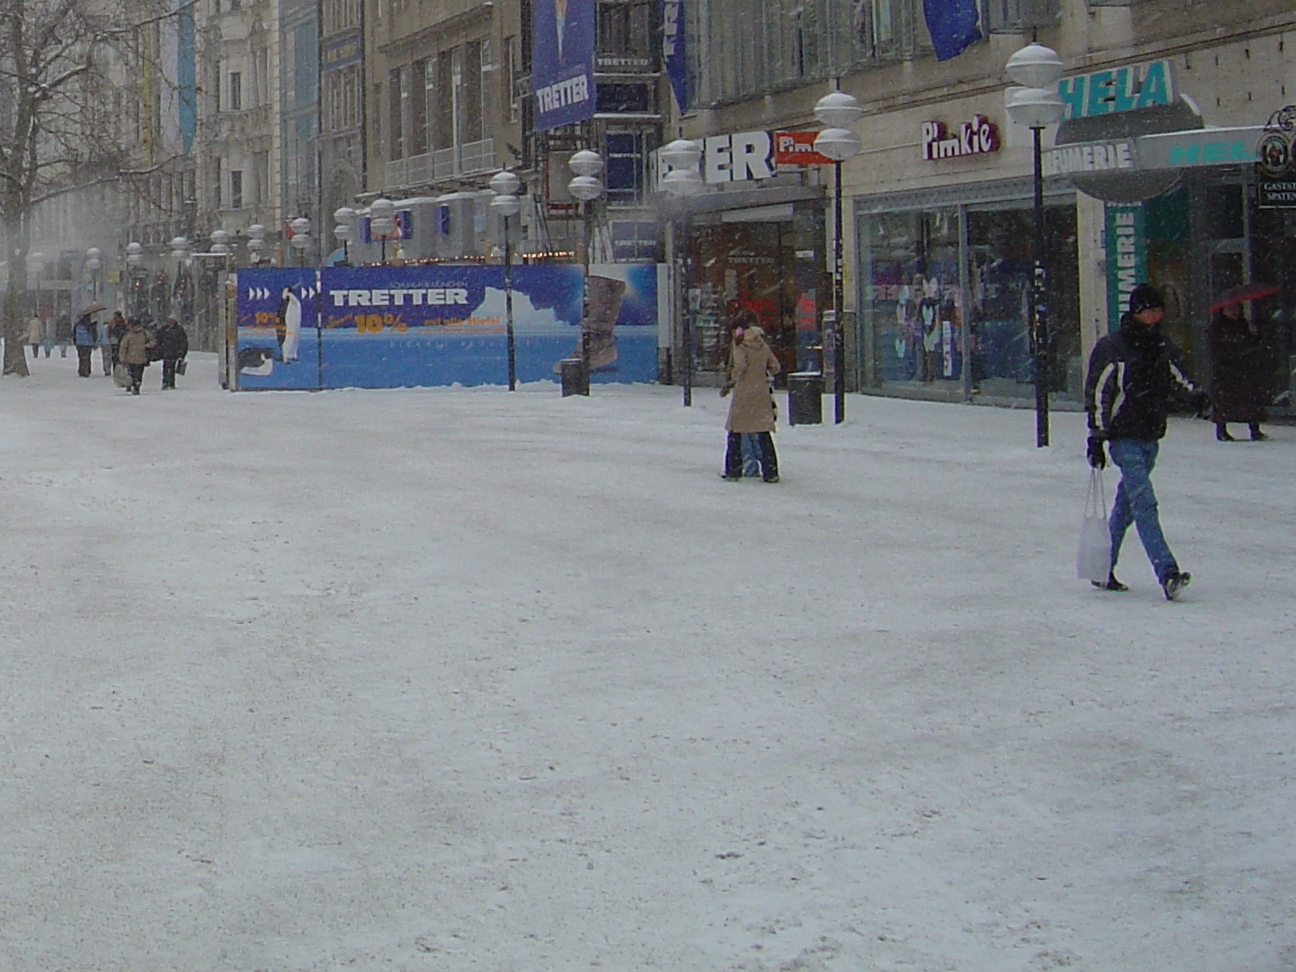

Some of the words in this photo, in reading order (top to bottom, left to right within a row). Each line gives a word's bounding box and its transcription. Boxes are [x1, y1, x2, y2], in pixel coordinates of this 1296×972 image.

[536, 74, 589, 114] TRETTER
[1058, 60, 1170, 121] HELA
[921, 114, 996, 161] Pimkie
[1168, 140, 1256, 165] HEL
[329, 288, 468, 307] TRETTER
[354, 313, 408, 334] 10%
